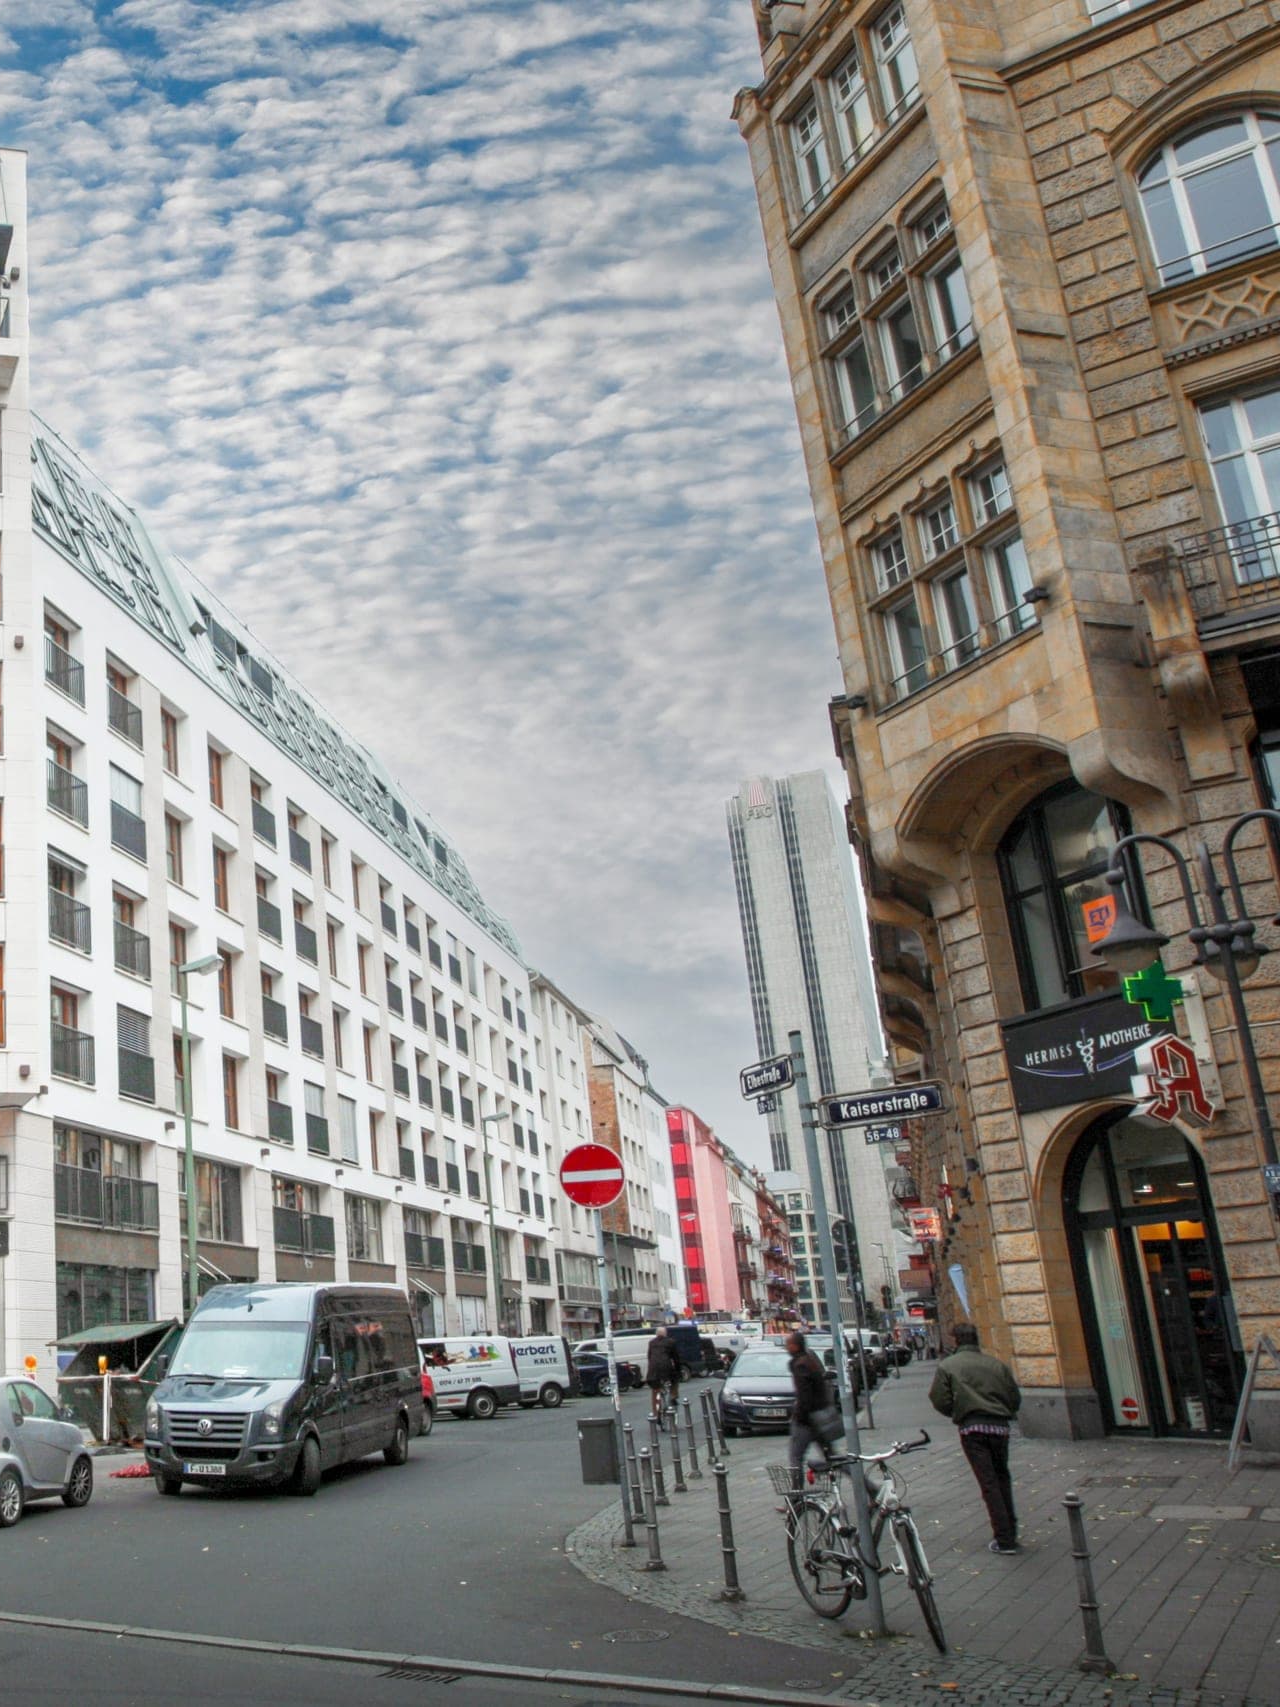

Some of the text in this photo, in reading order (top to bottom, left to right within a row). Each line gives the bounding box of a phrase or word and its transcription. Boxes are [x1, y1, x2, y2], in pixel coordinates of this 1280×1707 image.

[1025, 1023, 1152, 1067] HERMES APOTHEKE
[746, 1066, 782, 1090] Elbestraße
[840, 1092, 928, 1120] Kaiserstraße
[866, 1127, 900, 1143] 56-48
